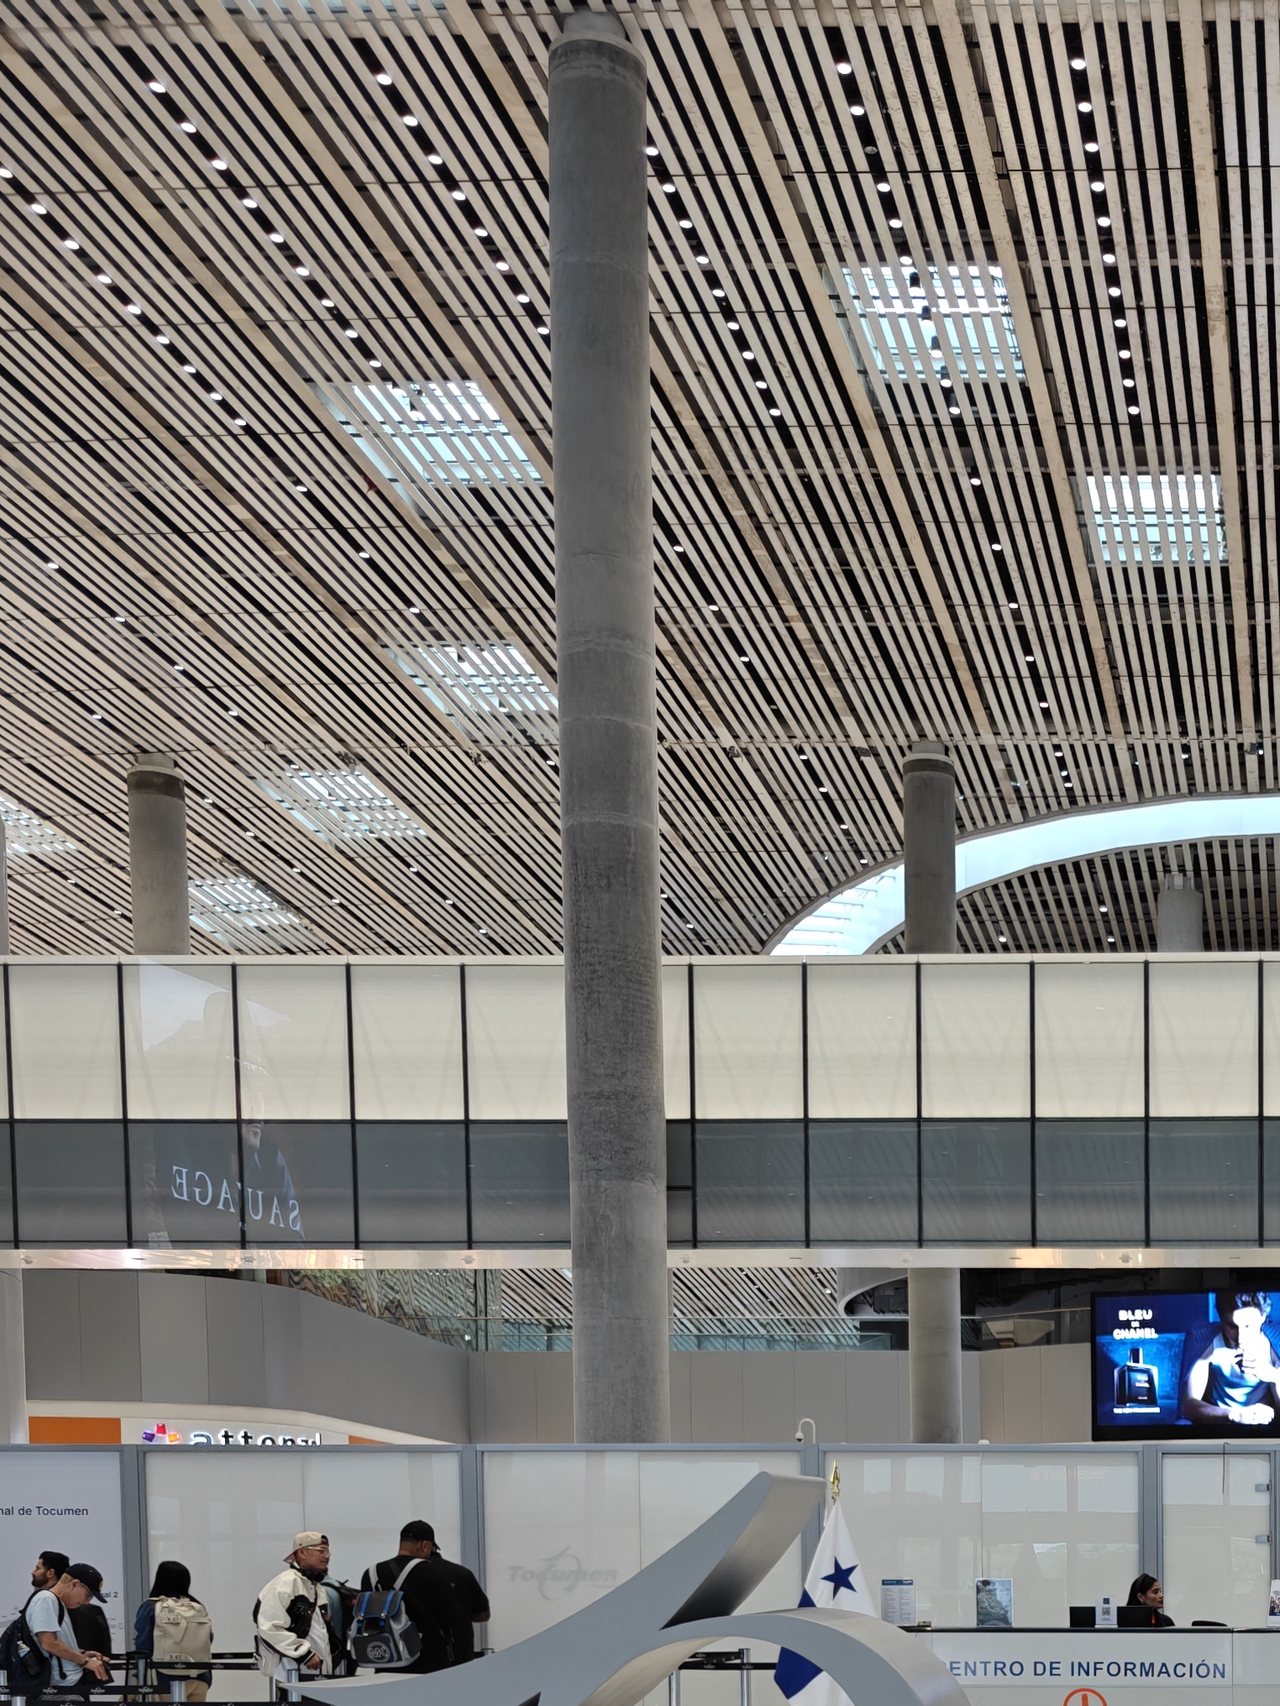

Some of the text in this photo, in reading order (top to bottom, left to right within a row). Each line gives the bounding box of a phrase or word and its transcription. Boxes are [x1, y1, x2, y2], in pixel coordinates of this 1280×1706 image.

[1119, 1309, 1152, 1321] BLEU
[1113, 1328, 1159, 1340] CHANEL
[17, 1505, 33, 1516] de
[35, 1505, 89, 1516] Tocumen
[943, 1659, 1226, 1679] ENTRO DE INFORMACIÓN
